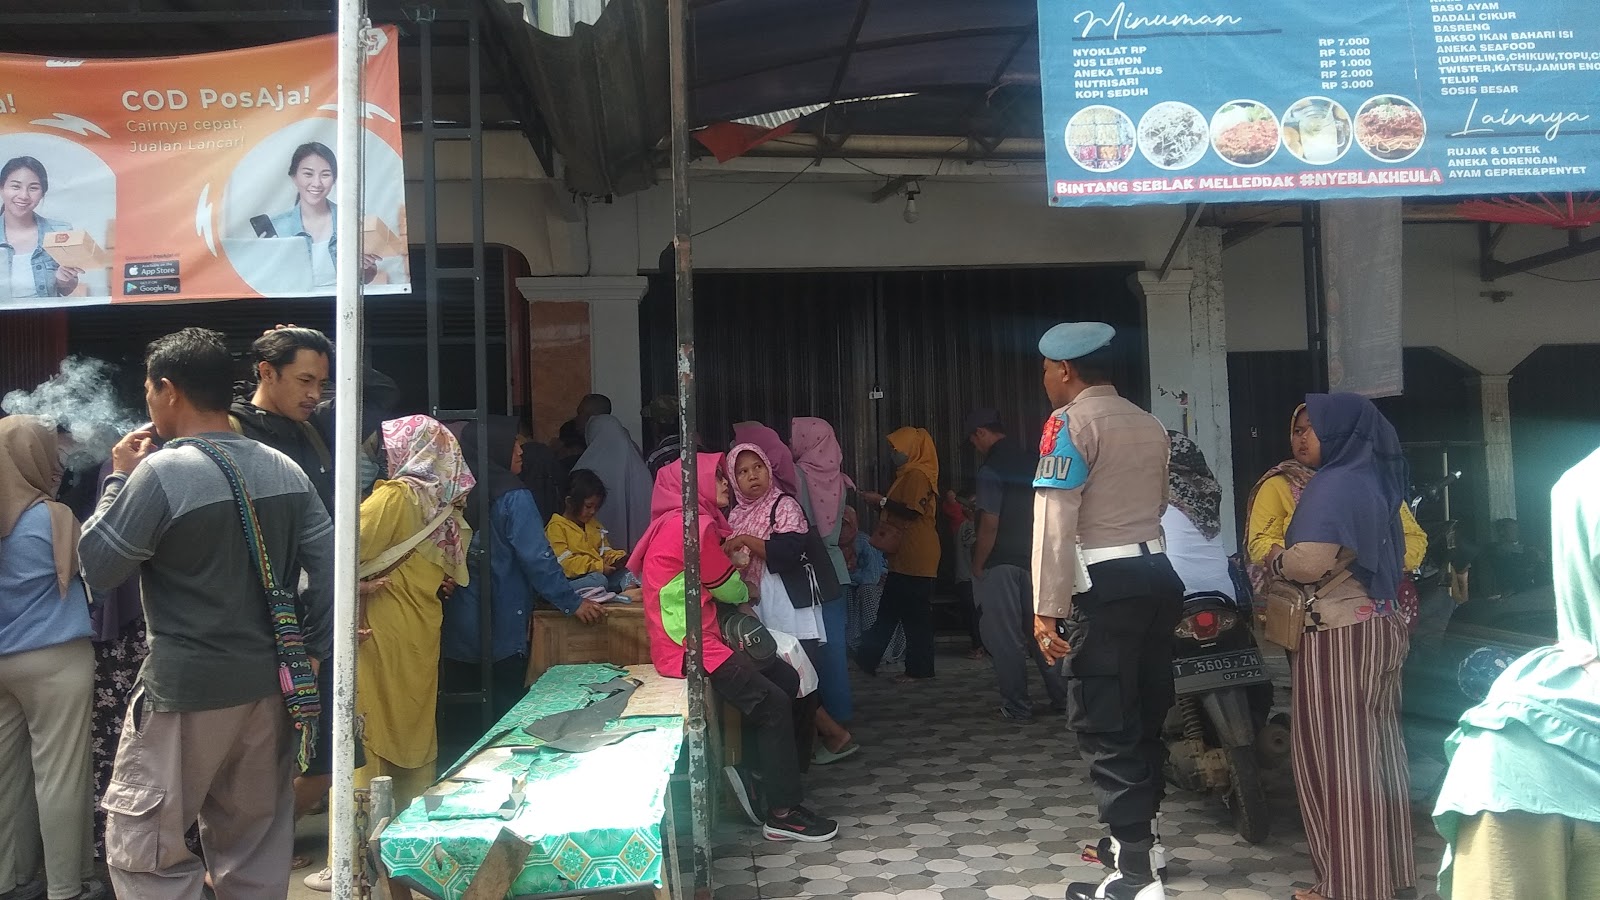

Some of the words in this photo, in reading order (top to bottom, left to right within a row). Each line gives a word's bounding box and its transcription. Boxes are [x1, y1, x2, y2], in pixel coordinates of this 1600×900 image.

[1431, 4, 1463, 13] BASO
[1467, 2, 1499, 11] AYAM
[1073, 2, 1242, 39] Minuman
[1432, 13, 1475, 23] DADALI
[1479, 12, 1516, 21] CIKUR
[1434, 23, 1490, 33] BASRENG
[1319, 38, 1335, 46] RP
[1338, 37, 1370, 46] 7.000
[1435, 34, 1476, 43] BAKSO
[1479, 33, 1508, 41] IKAN
[1511, 31, 1556, 40] BAHARI
[1559, 30, 1573, 39] ISI
[1073, 47, 1127, 57] NYOKLAT
[1131, 46, 1147, 54] RP
[1319, 49, 1336, 57] RP
[1339, 48, 1371, 56] 5.000
[1436, 44, 1477, 54] ANEKA
[1480, 42, 1536, 52] SEAFOOD
[1074, 58, 1097, 67] JUS
[1100, 57, 1141, 66] LEMON
[1320, 60, 1337, 68] RP
[1340, 58, 1372, 67] 1.000
[1438, 51, 1600, 65] (DUMPLING,CHIKUW,TOPU,C
[1074, 68, 1114, 78] ANEKA
[1117, 66, 1163, 76] TEAJUS
[1438, 62, 1576, 74] TWISTER,KATSU,JAMUR
[1321, 70, 1337, 79] RP
[1341, 69, 1373, 78] 2.000
[1440, 75, 1479, 84] TELUR
[1075, 77, 1139, 88] NUTRISARI
[1321, 81, 1338, 90] RP
[1341, 80, 1374, 89] 3.000
[1075, 89, 1104, 99] KOPI
[1107, 87, 1149, 98] SEDUH
[1441, 86, 1477, 96] SOSIS
[1481, 85, 1519, 94] BESAR
[121, 89, 188, 111] COD
[200, 84, 311, 111] PosAja!
[1451, 98, 1590, 141] Lainnya
[126, 120, 188, 134] Cairnya
[193, 118, 243, 132] cepat,
[130, 141, 182, 153] Jualan
[188, 137, 244, 151] Lancar!
[1447, 147, 1487, 157] RUJAK
[1491, 146, 1500, 155] &
[1503, 145, 1541, 155] LOTEK
[1448, 158, 1488, 167] ANEKA
[1492, 156, 1558, 166] GORENGAN
[1449, 169, 1481, 178] AYAM
[1485, 166, 1587, 177] GEPREK&PENYET
[1057, 181, 1128, 194] BINTANG
[1133, 178, 1194, 191] SEBLAK
[1199, 175, 1295, 189] MELLEDDAK
[1299, 170, 1442, 187] #NYEBLAKHEULA
[141, 268, 156, 276] App
[140, 285, 163, 293] Google
[163, 284, 178, 292] Play
[1174, 664, 1183, 676] T
[1196, 658, 1231, 672] 5605
